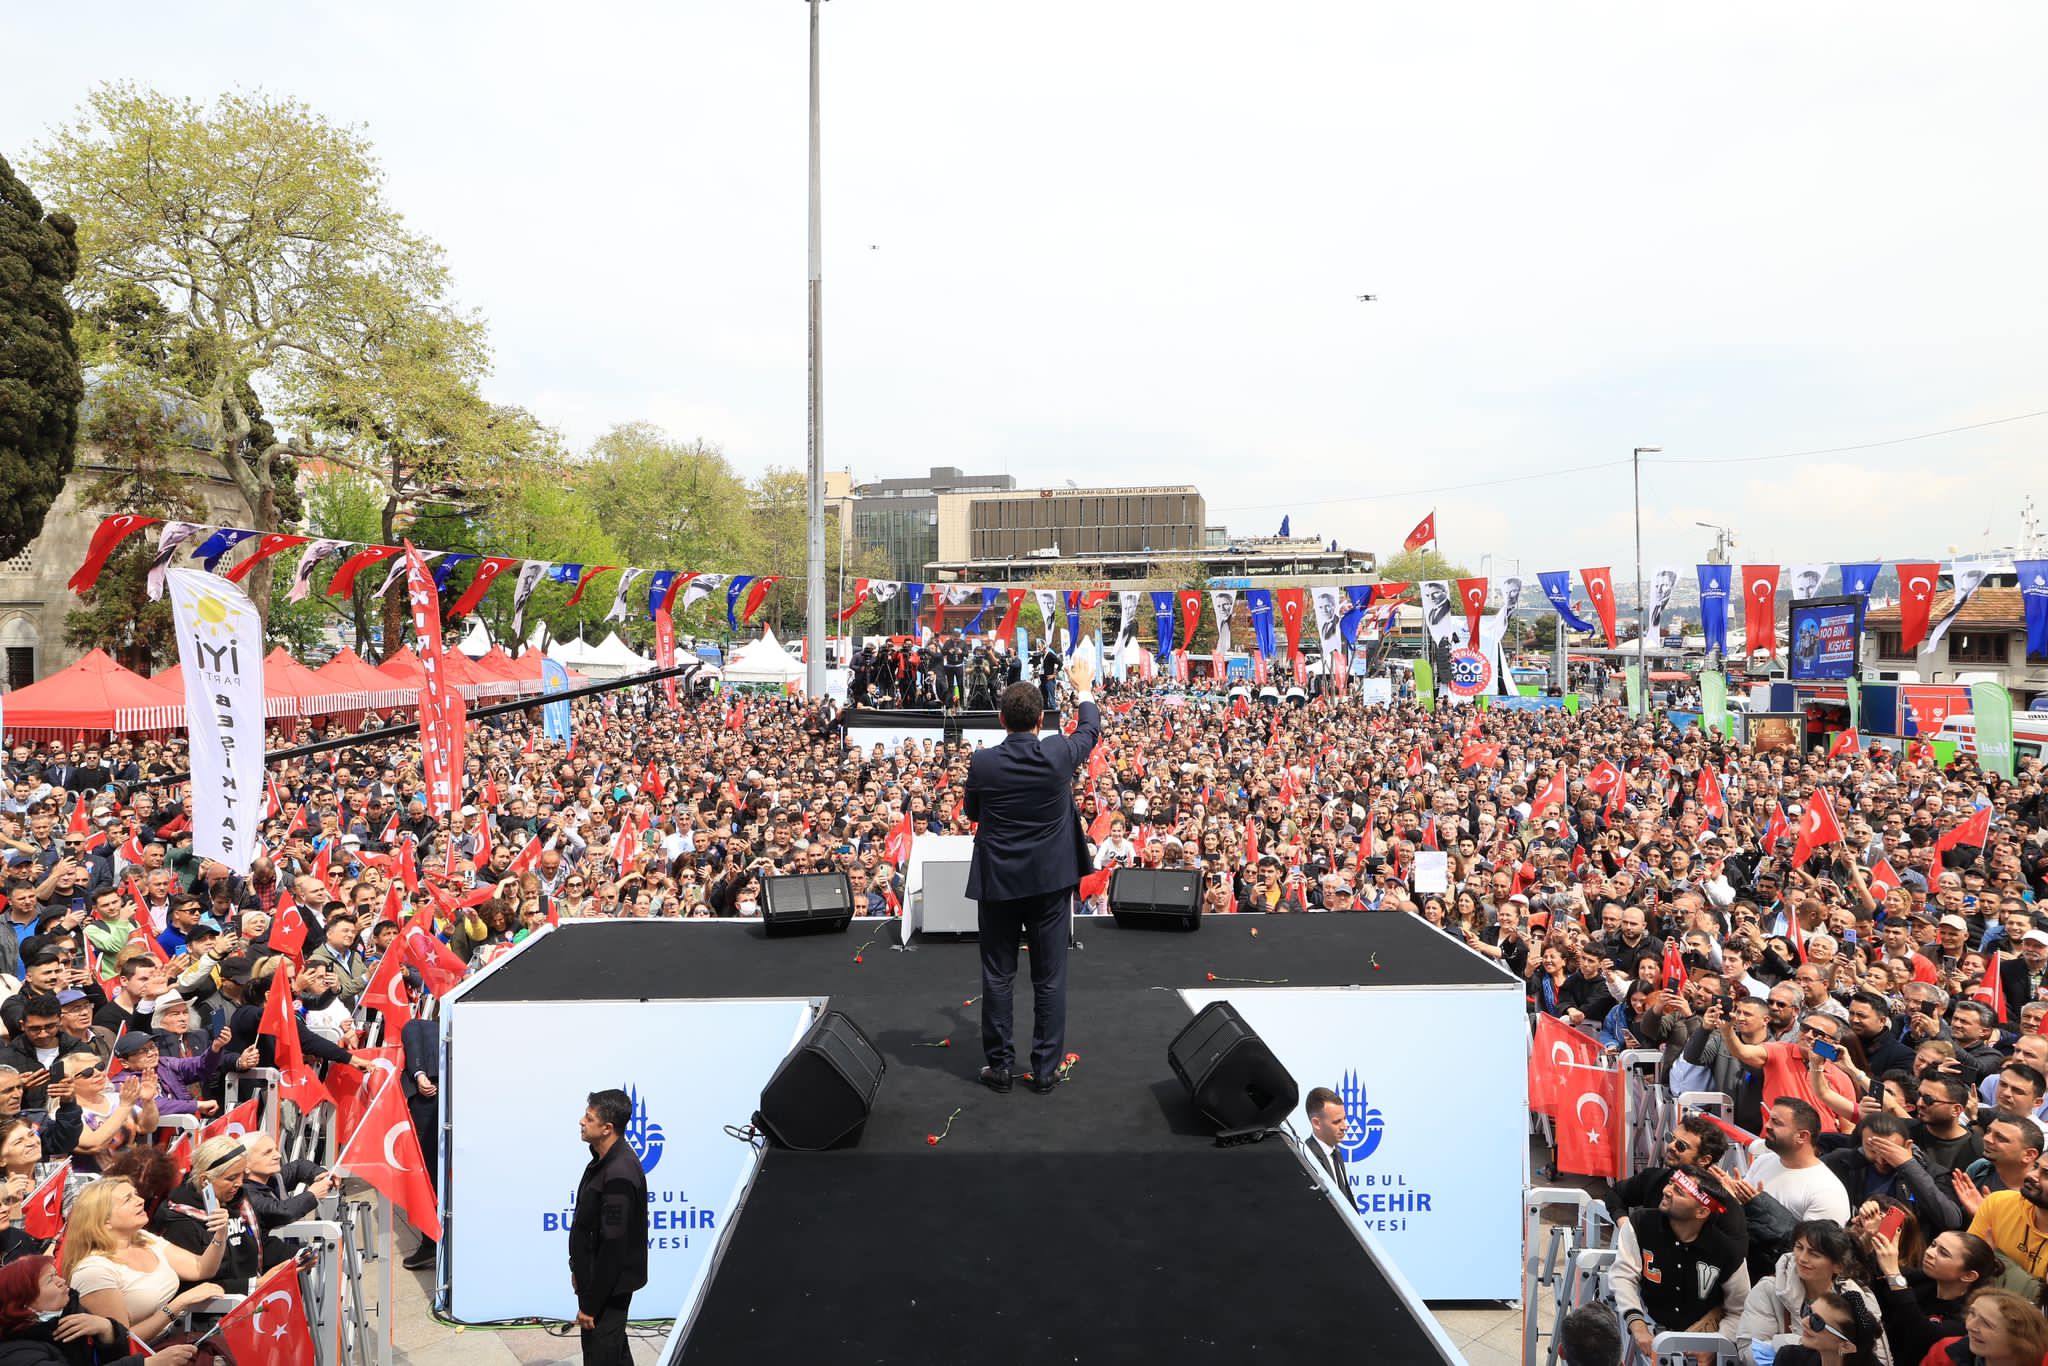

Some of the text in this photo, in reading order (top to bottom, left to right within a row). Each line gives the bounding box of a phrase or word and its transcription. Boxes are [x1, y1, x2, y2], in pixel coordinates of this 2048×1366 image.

[1820, 628, 1832, 639] 100
[1453, 674, 1483, 682] ROJE
[1356, 1189, 1432, 1215] ŞEHİR
[1695, 1260, 1721, 1299] V
